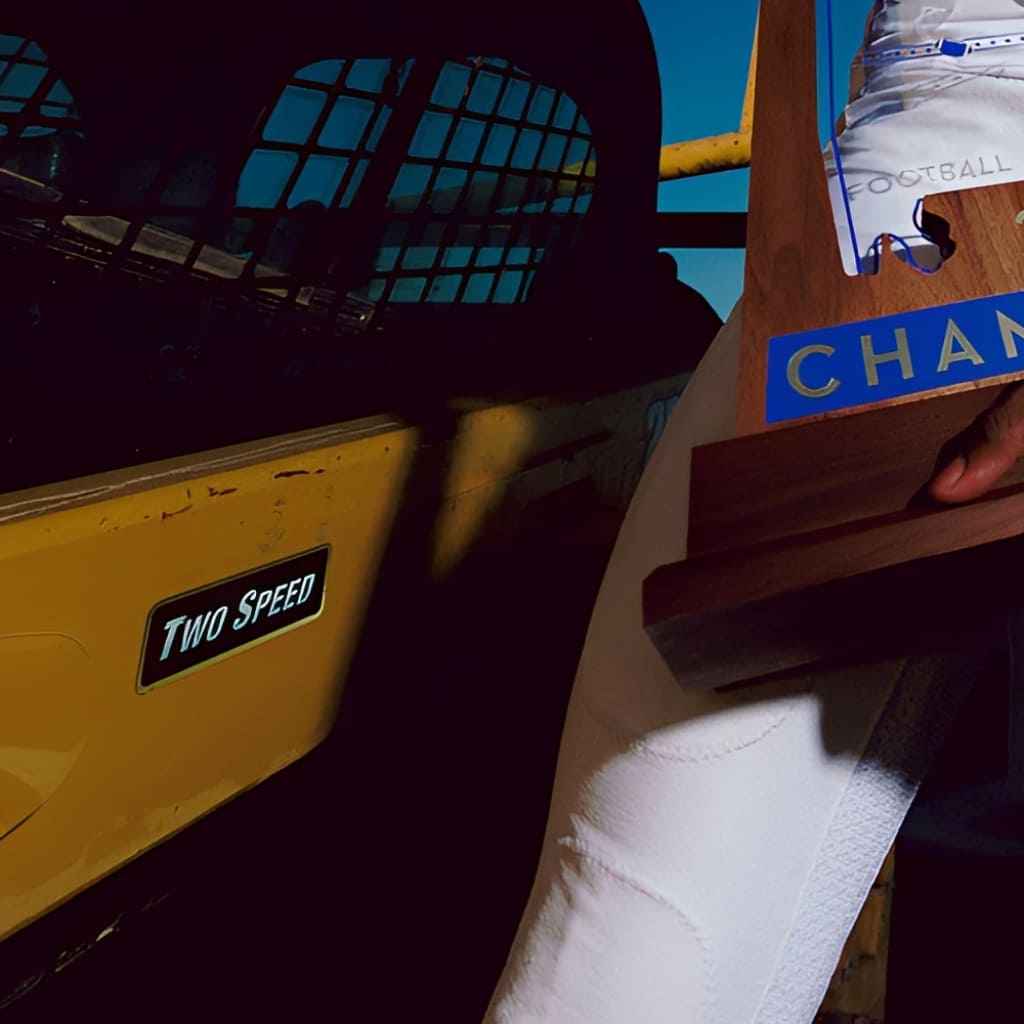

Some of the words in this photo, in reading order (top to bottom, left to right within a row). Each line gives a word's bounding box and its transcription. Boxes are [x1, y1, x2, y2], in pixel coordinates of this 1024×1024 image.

[846, 155, 1013, 201] FOOTBALL
[159, 605, 229, 661] TWO
[232, 573, 316, 631] SPEED
